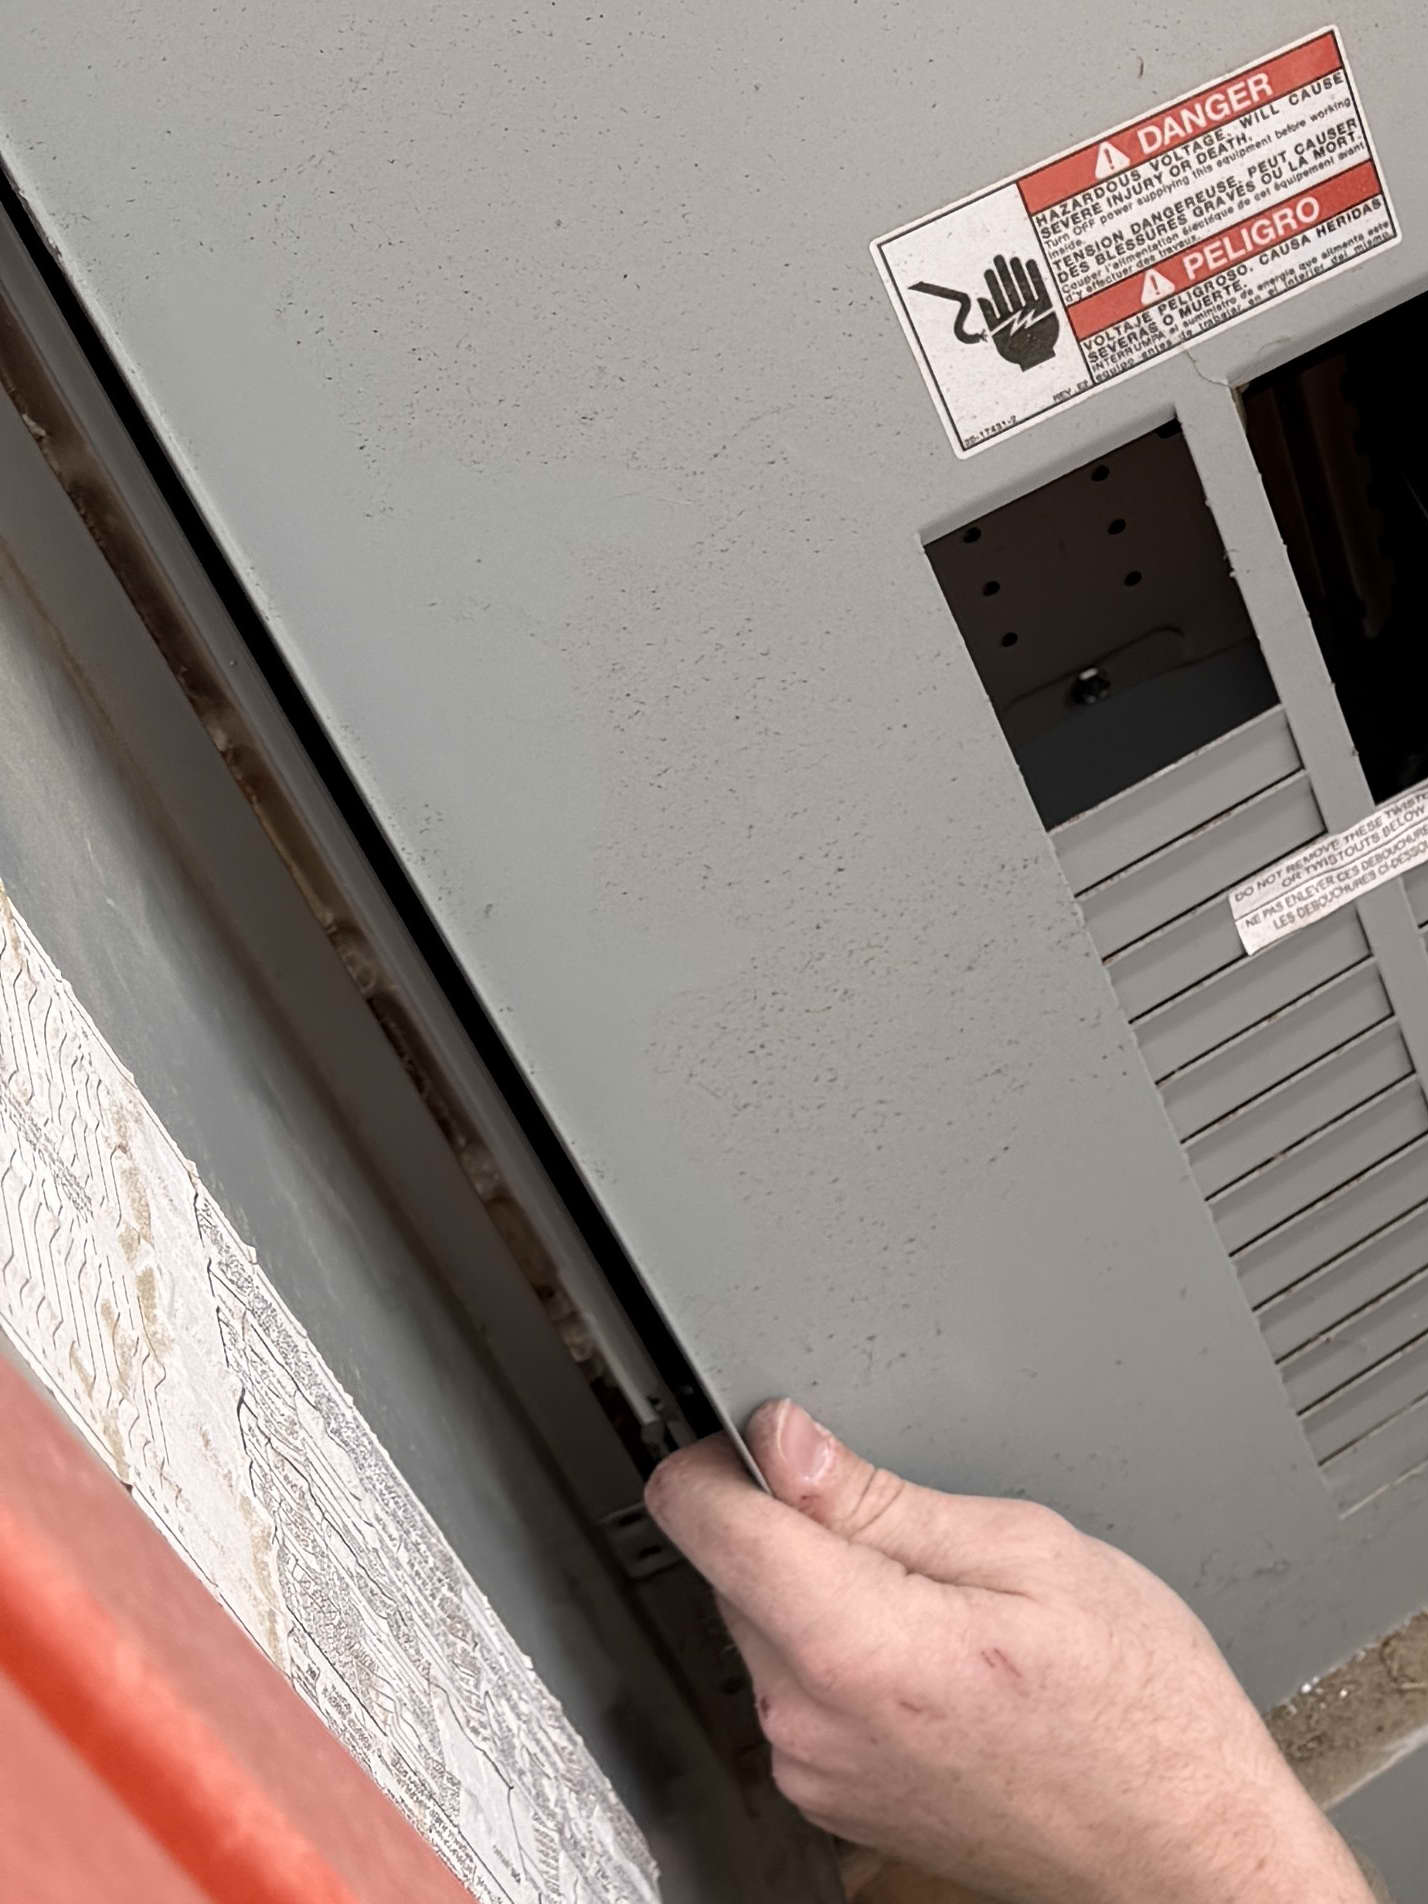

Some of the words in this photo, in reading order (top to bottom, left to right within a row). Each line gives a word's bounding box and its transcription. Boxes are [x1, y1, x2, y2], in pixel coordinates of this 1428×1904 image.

[1035, 169, 1142, 228] HAZARDOUS
[1239, 104, 1280, 129] WILL
[1288, 72, 1344, 106] CAUSE
[1137, 73, 1273, 155] DANGER
[1041, 202, 1103, 240] SEVERE
[1106, 172, 1163, 209] INJURY
[1169, 160, 1193, 178] OR
[1044, 233, 1071, 250] Turn
[1073, 219, 1095, 236] OFF
[1100, 203, 1133, 226] power
[1137, 176, 1191, 206] supplying
[1192, 164, 1214, 179] this
[1216, 134, 1273, 168] equipment
[1274, 120, 1307, 140] before
[1310, 97, 1352, 123] working
[1052, 230, 1125, 272] TENSION
[1247, 150, 1287, 179] PEUT
[1294, 118, 1358, 156] CAUSER
[1237, 198, 1251, 211] de
[1057, 261, 1091, 285] DES
[1095, 213, 1188, 266] BLESSURES
[1192, 181, 1256, 218] GRAVES
[1261, 167, 1283, 185] OU
[1288, 156, 1309, 173] LA
[1183, 197, 1320, 281] PELIGRO
[1083, 311, 1153, 352] VOLTAJE
[1259, 234, 1312, 266] CAUSA
[1316, 198, 1382, 238] HERIDAS
[1136, 255, 1156, 269] des
[1088, 322, 1159, 364] SEVERAS
[1163, 314, 1174, 327] O
[1234, 886, 1255, 903] DO
[1257, 869, 1283, 891] NOT
[1245, 914, 1261, 928] NE
[1262, 901, 1284, 919] PAS
[1281, 871, 1302, 888] OR
[1273, 912, 1296, 931] LES
